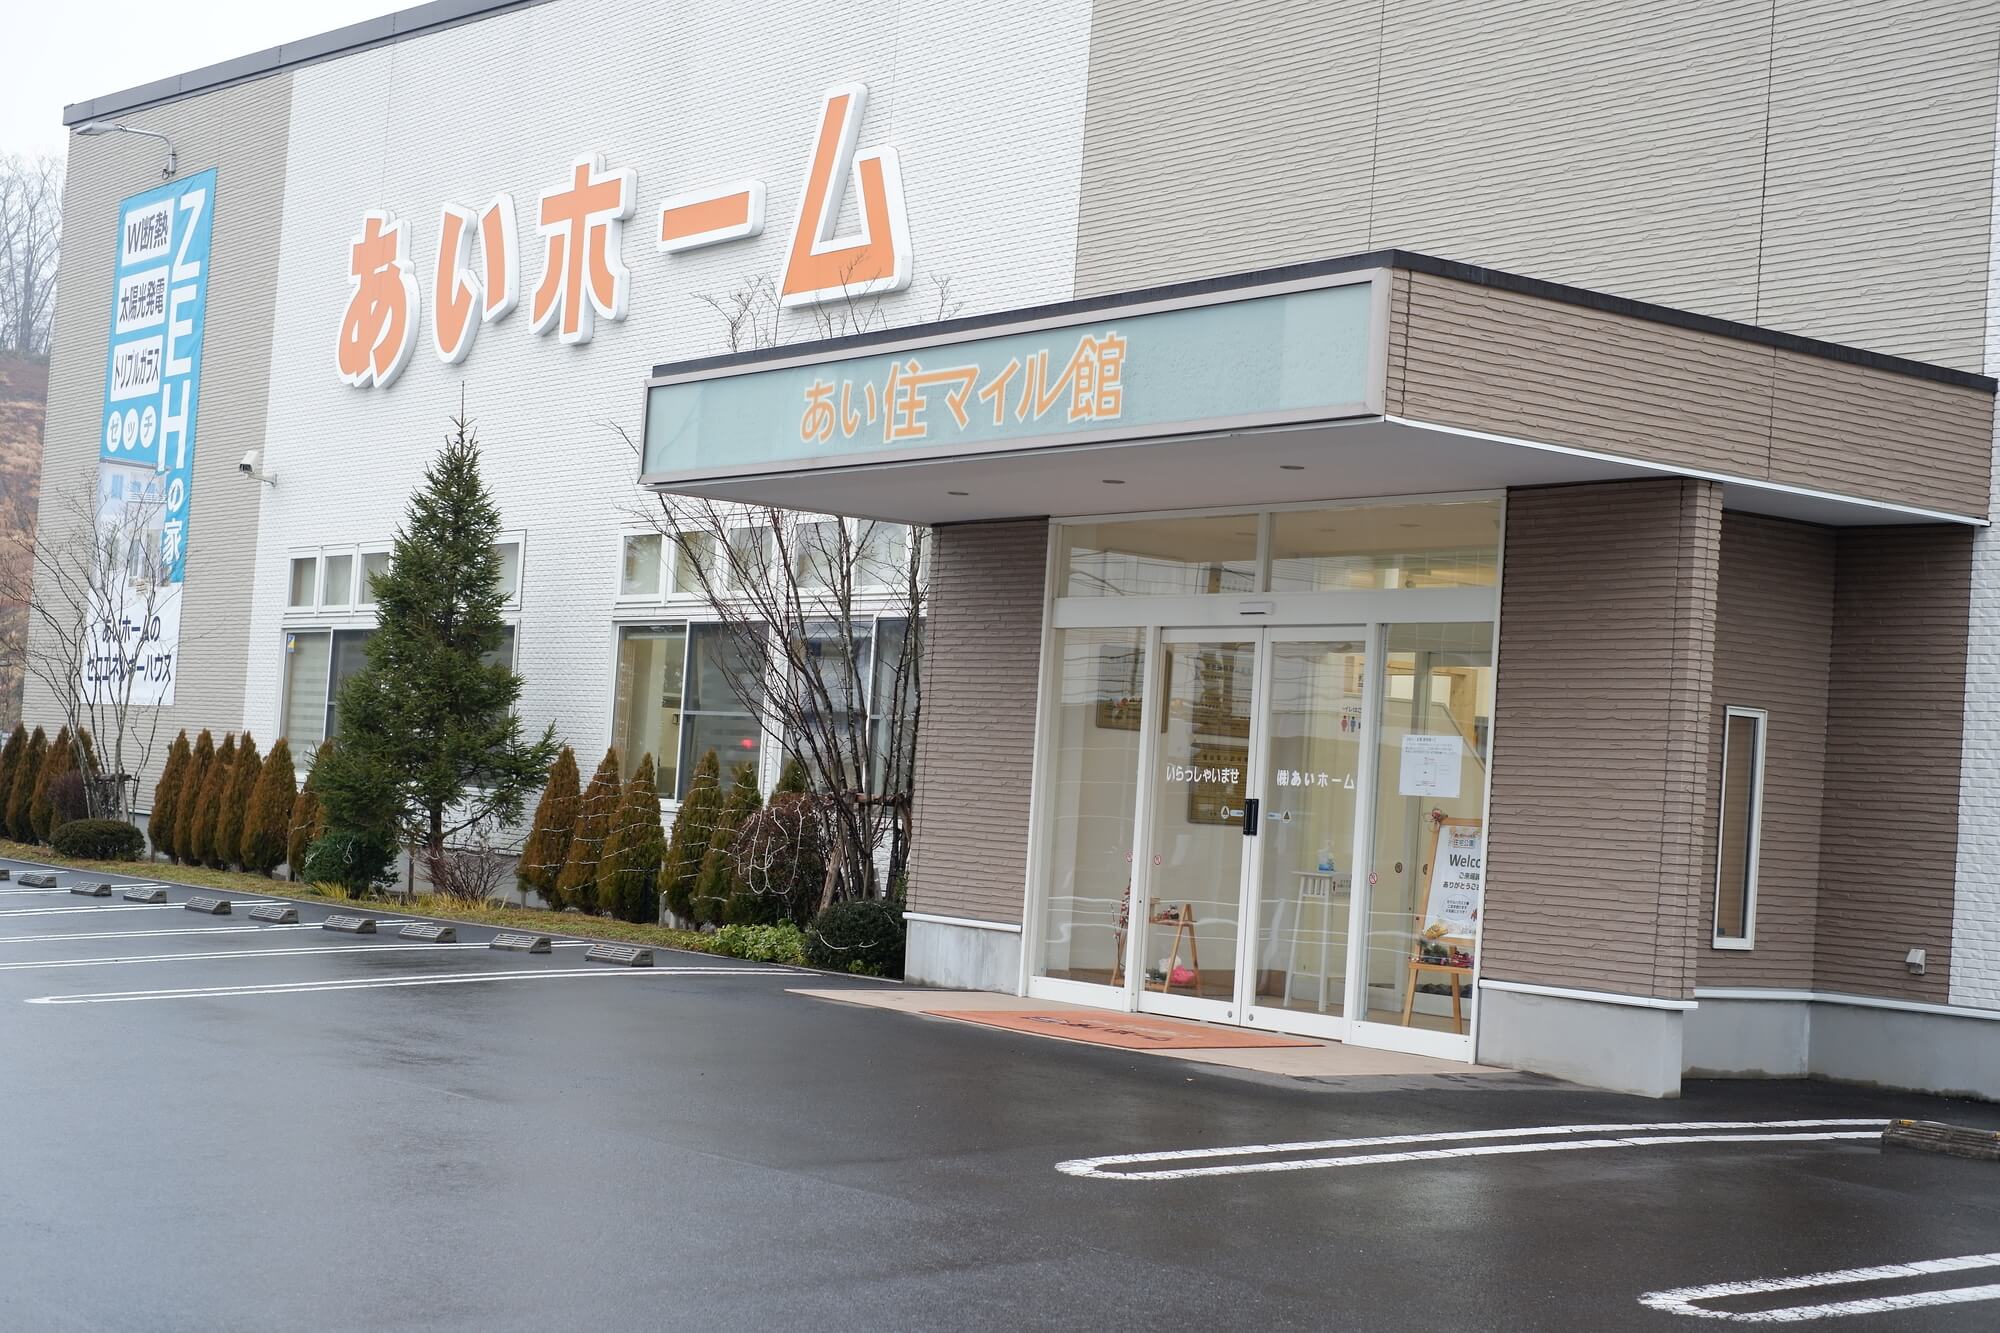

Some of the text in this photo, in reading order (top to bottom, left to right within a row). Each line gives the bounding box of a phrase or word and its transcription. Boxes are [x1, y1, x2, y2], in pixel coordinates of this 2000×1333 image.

[127, 210, 169, 254] W断熱
[336, 82, 913, 388] あいホーム
[119, 277, 165, 323] 太陽光発電
[114, 348, 160, 391] トリプルガラス
[800, 331, 1127, 444] あい住マイル館
[1166, 765, 1240, 784] いらっしゃいませ
